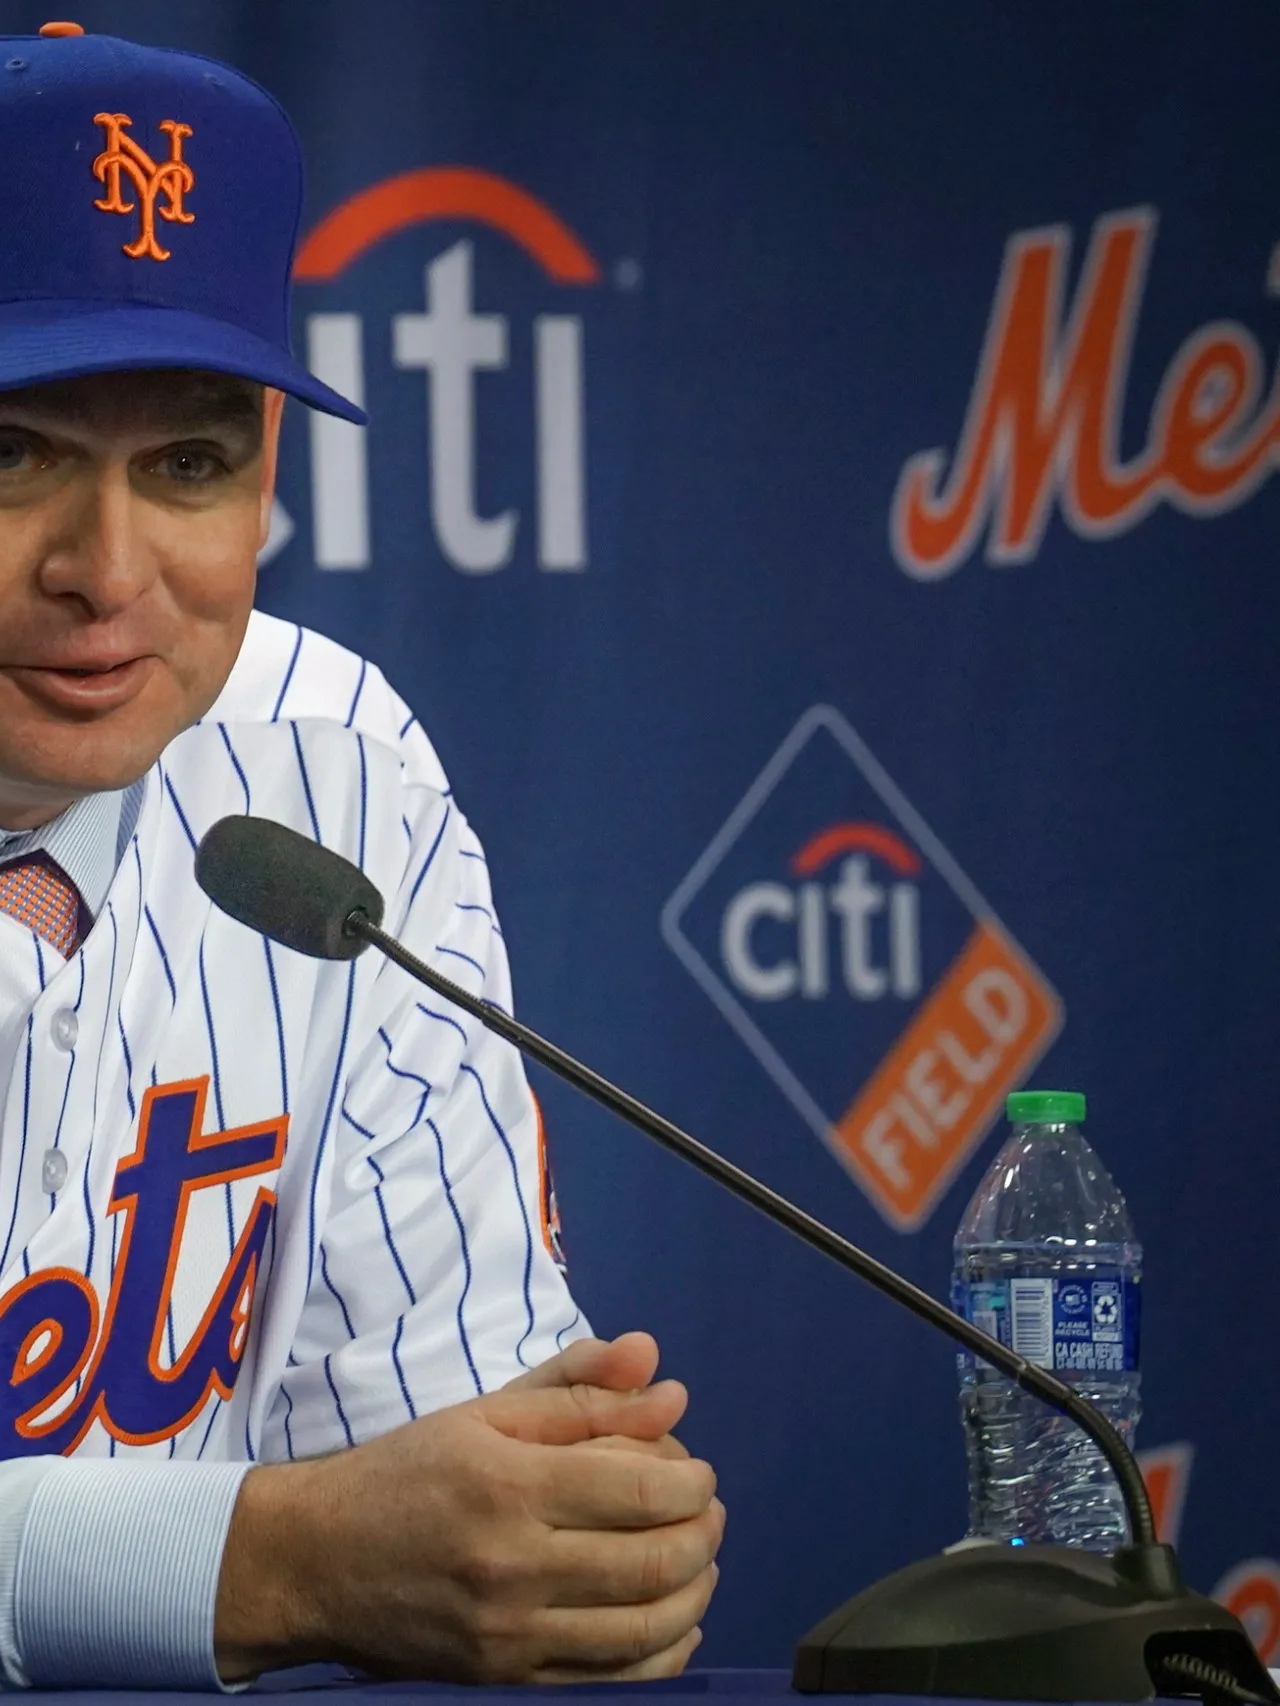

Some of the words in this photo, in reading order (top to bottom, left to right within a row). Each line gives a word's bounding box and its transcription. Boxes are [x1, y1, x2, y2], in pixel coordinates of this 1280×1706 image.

[258, 238, 588, 576] iti
[888, 204, 1280, 583] Me
[722, 853, 920, 1001] citi
[860, 965, 1030, 1193] FIELD
